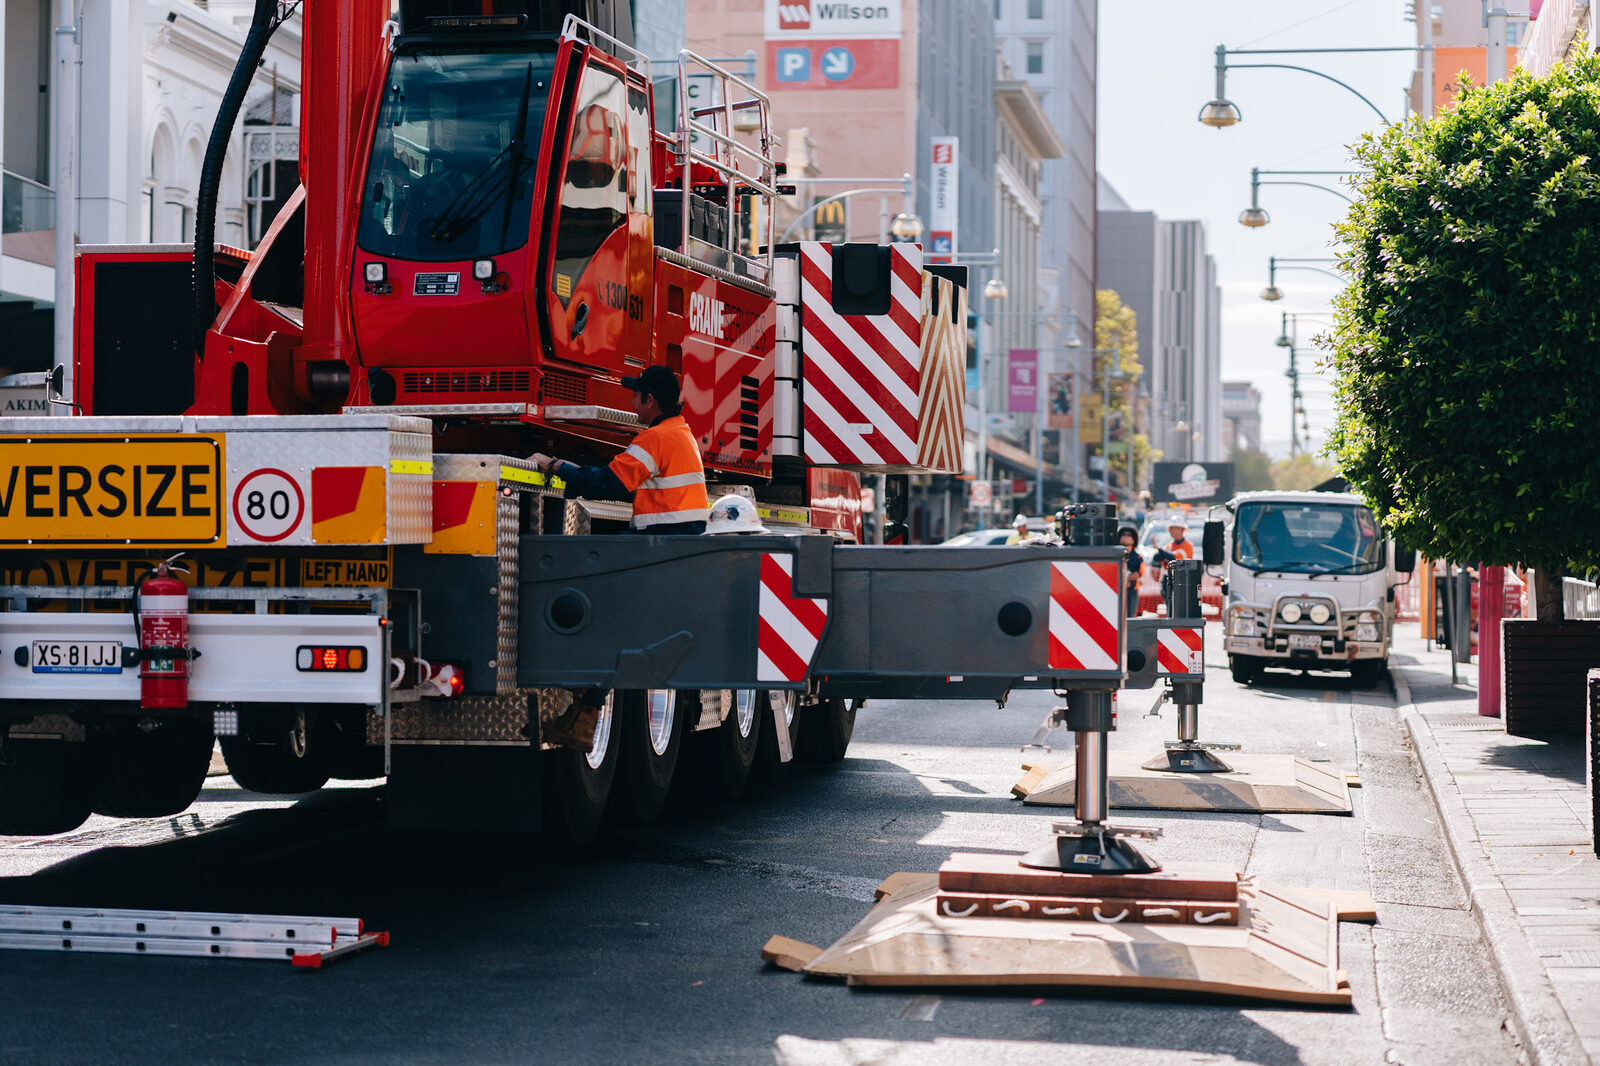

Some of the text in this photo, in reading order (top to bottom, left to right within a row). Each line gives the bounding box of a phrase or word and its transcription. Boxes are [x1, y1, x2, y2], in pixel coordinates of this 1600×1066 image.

[817, 4, 888, 19] Wilson
[784, 53, 805, 76] P
[937, 167, 948, 209] Wilson
[606, 281, 643, 322] 1300 631
[247, 491, 290, 520] 80
[305, 562, 388, 582] LEFT HAND
